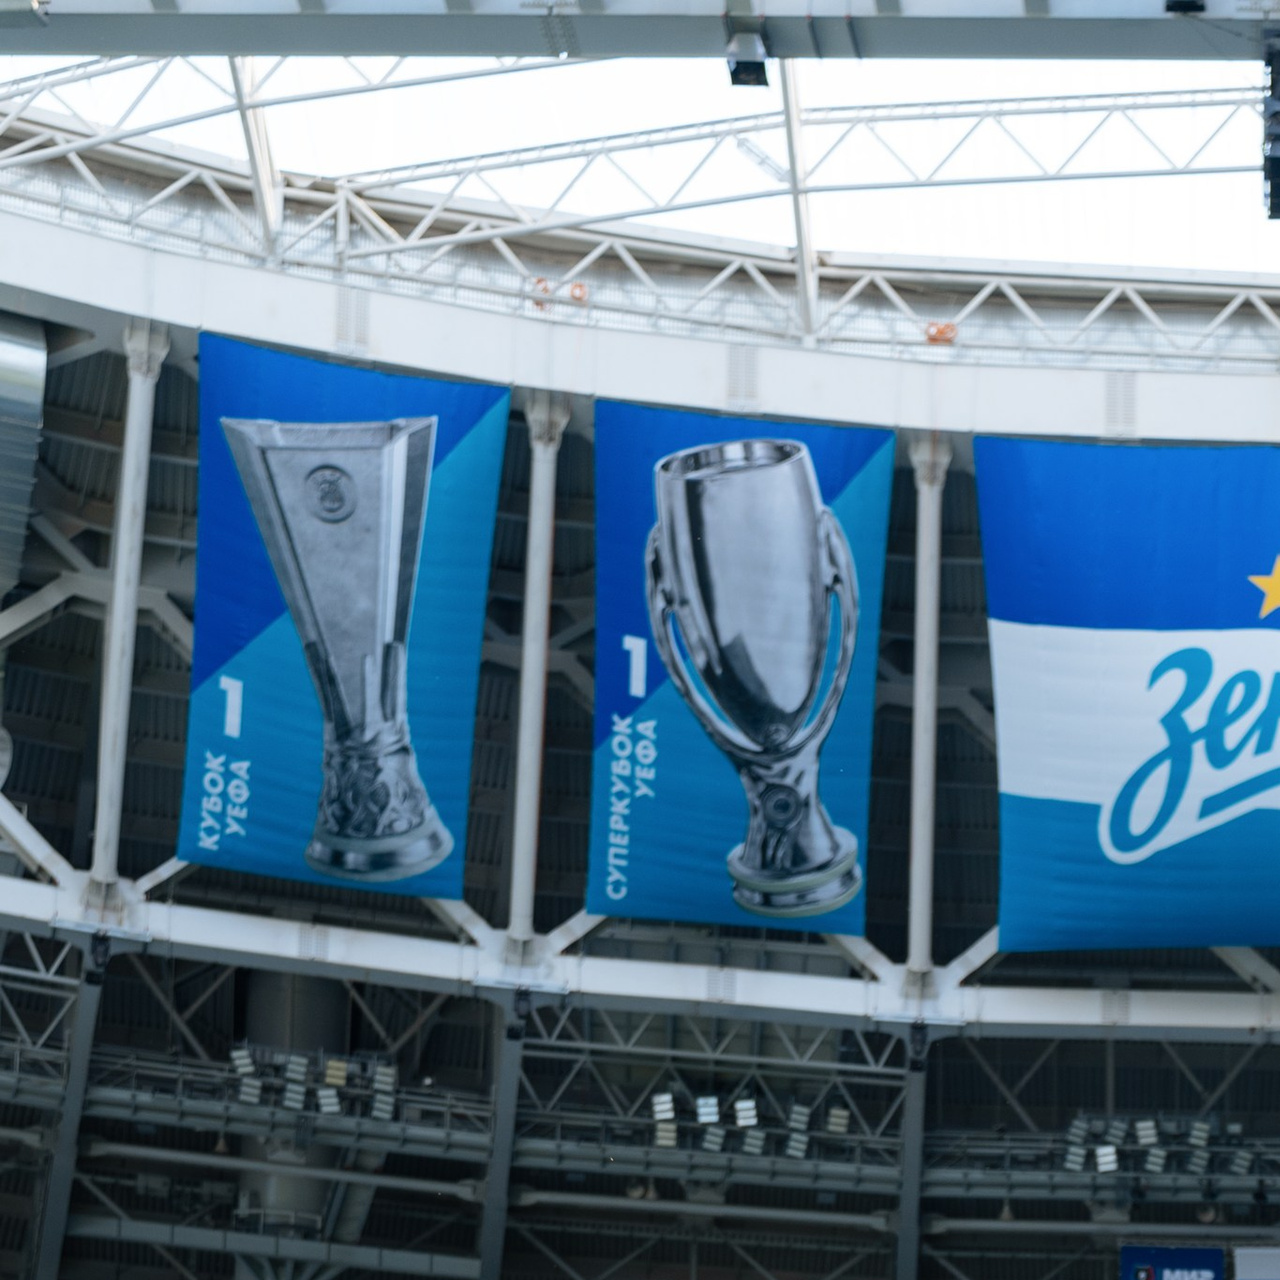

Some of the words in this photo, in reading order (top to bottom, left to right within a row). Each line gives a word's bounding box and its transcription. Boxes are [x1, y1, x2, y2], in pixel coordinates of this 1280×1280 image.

[622, 634, 648, 698] 1
[218, 675, 244, 738] 1
[634, 719, 658, 798] УЕФА
[198, 750, 227, 850] КУБОК
[225, 760, 251, 836] УЕФА
[605, 713, 633, 900] СУПЕРКУБОК
